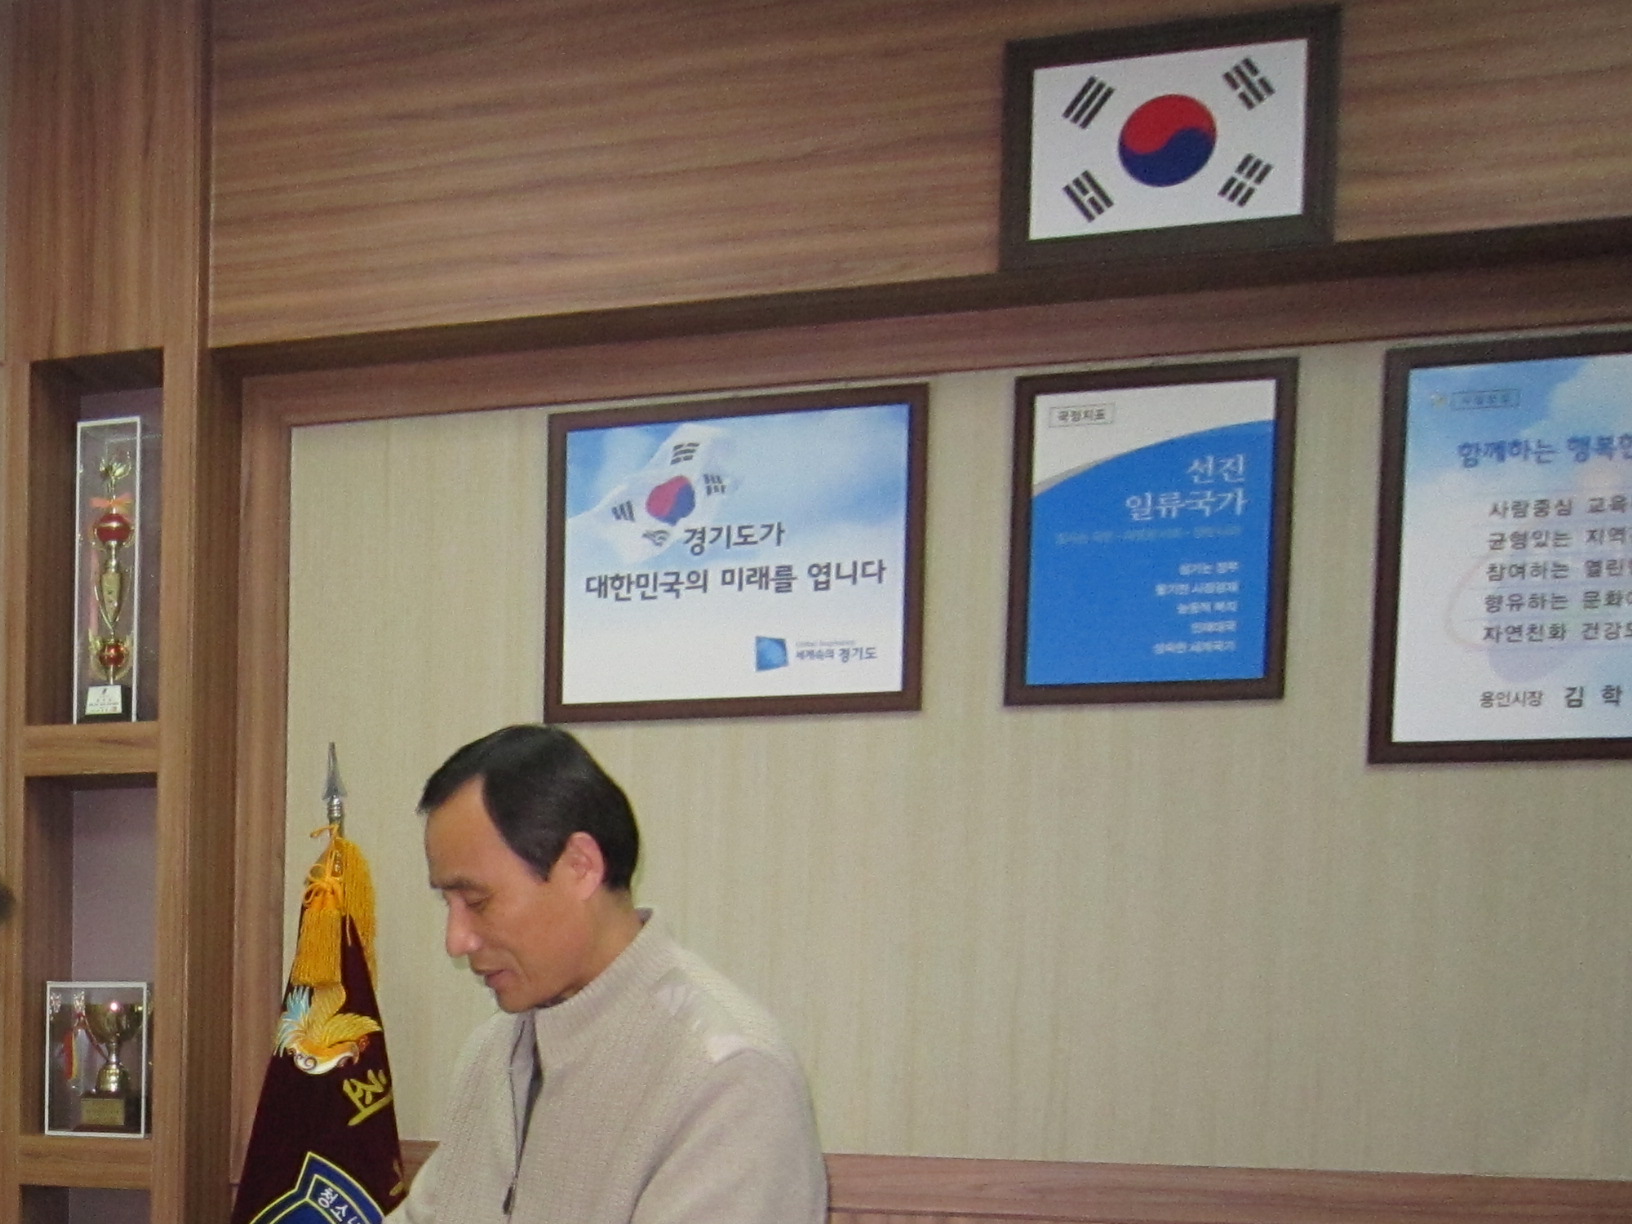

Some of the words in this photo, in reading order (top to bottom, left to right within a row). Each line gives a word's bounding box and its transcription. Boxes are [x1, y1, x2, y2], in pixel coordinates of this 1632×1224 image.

[1457, 438, 1558, 469] 함께하는
[1187, 453, 1246, 485] 선진
[1125, 487, 1248, 521] 일류국가
[1489, 497, 1573, 518] 사람중심
[1586, 494, 1632, 514] 교육
[683, 522, 786, 557] 경기도가
[1487, 529, 1573, 551] 균형있는
[1585, 526, 1632, 546] 지역
[585, 568, 709, 603] 대한민국의
[720, 565, 798, 595] 미래를
[807, 559, 887, 591] 엽니다
[1486, 560, 1570, 582] 참여하는
[1584, 558, 1632, 579] 열린
[1484, 592, 1569, 613] 향유하는
[1482, 622, 1567, 644] 자연친화
[839, 646, 878, 663] 경기도
[1480, 690, 1544, 708] 용인시장
[1564, 685, 1585, 709] 김
[1601, 683, 1624, 707] 학
